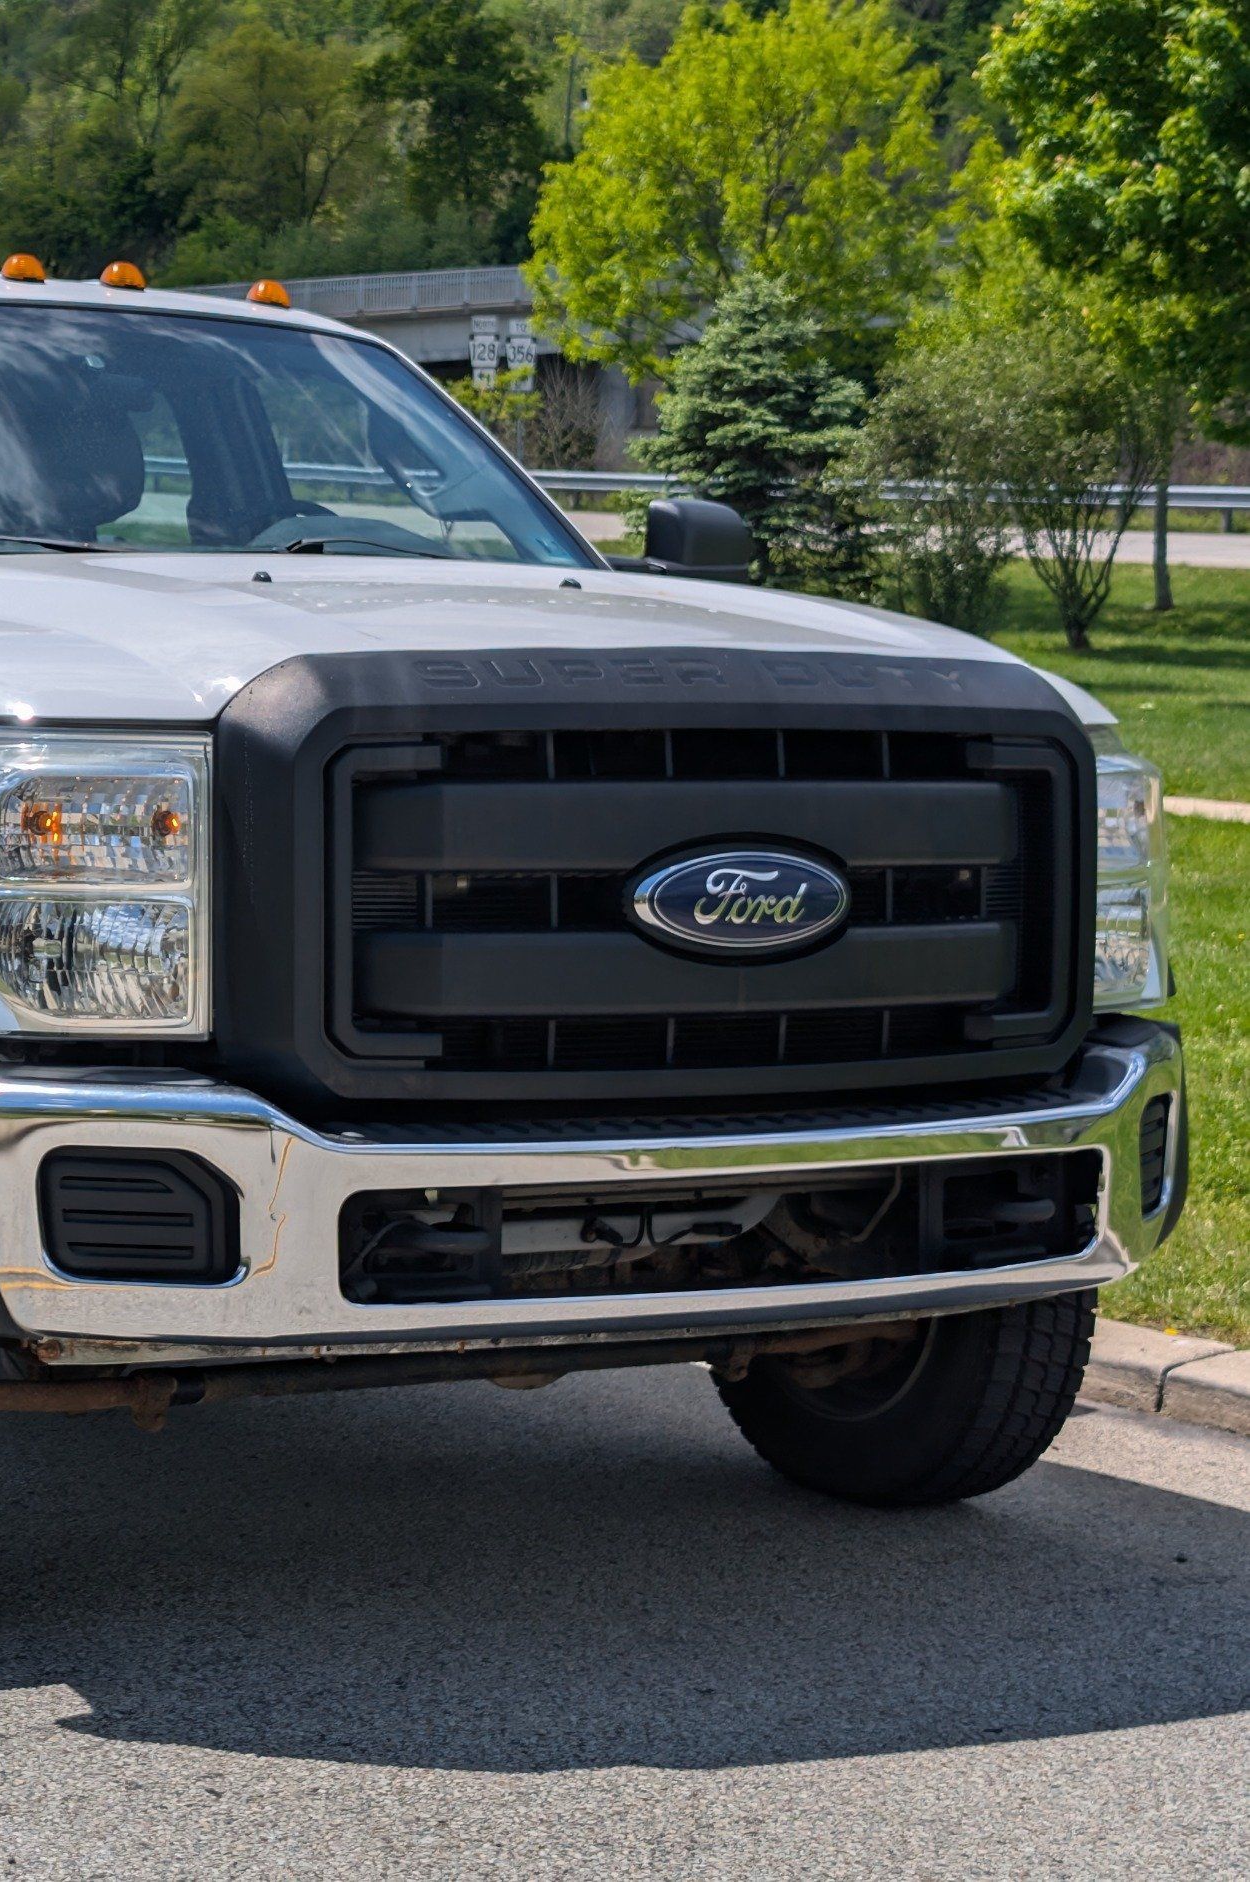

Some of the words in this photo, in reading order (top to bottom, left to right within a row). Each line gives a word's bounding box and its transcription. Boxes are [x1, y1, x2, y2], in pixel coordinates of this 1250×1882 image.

[472, 343, 496, 361] 128
[509, 345, 533, 363] 356
[414, 657, 730, 689] SUPER
[760, 659, 964, 691] DUTY
[693, 867, 808, 926] Ford
